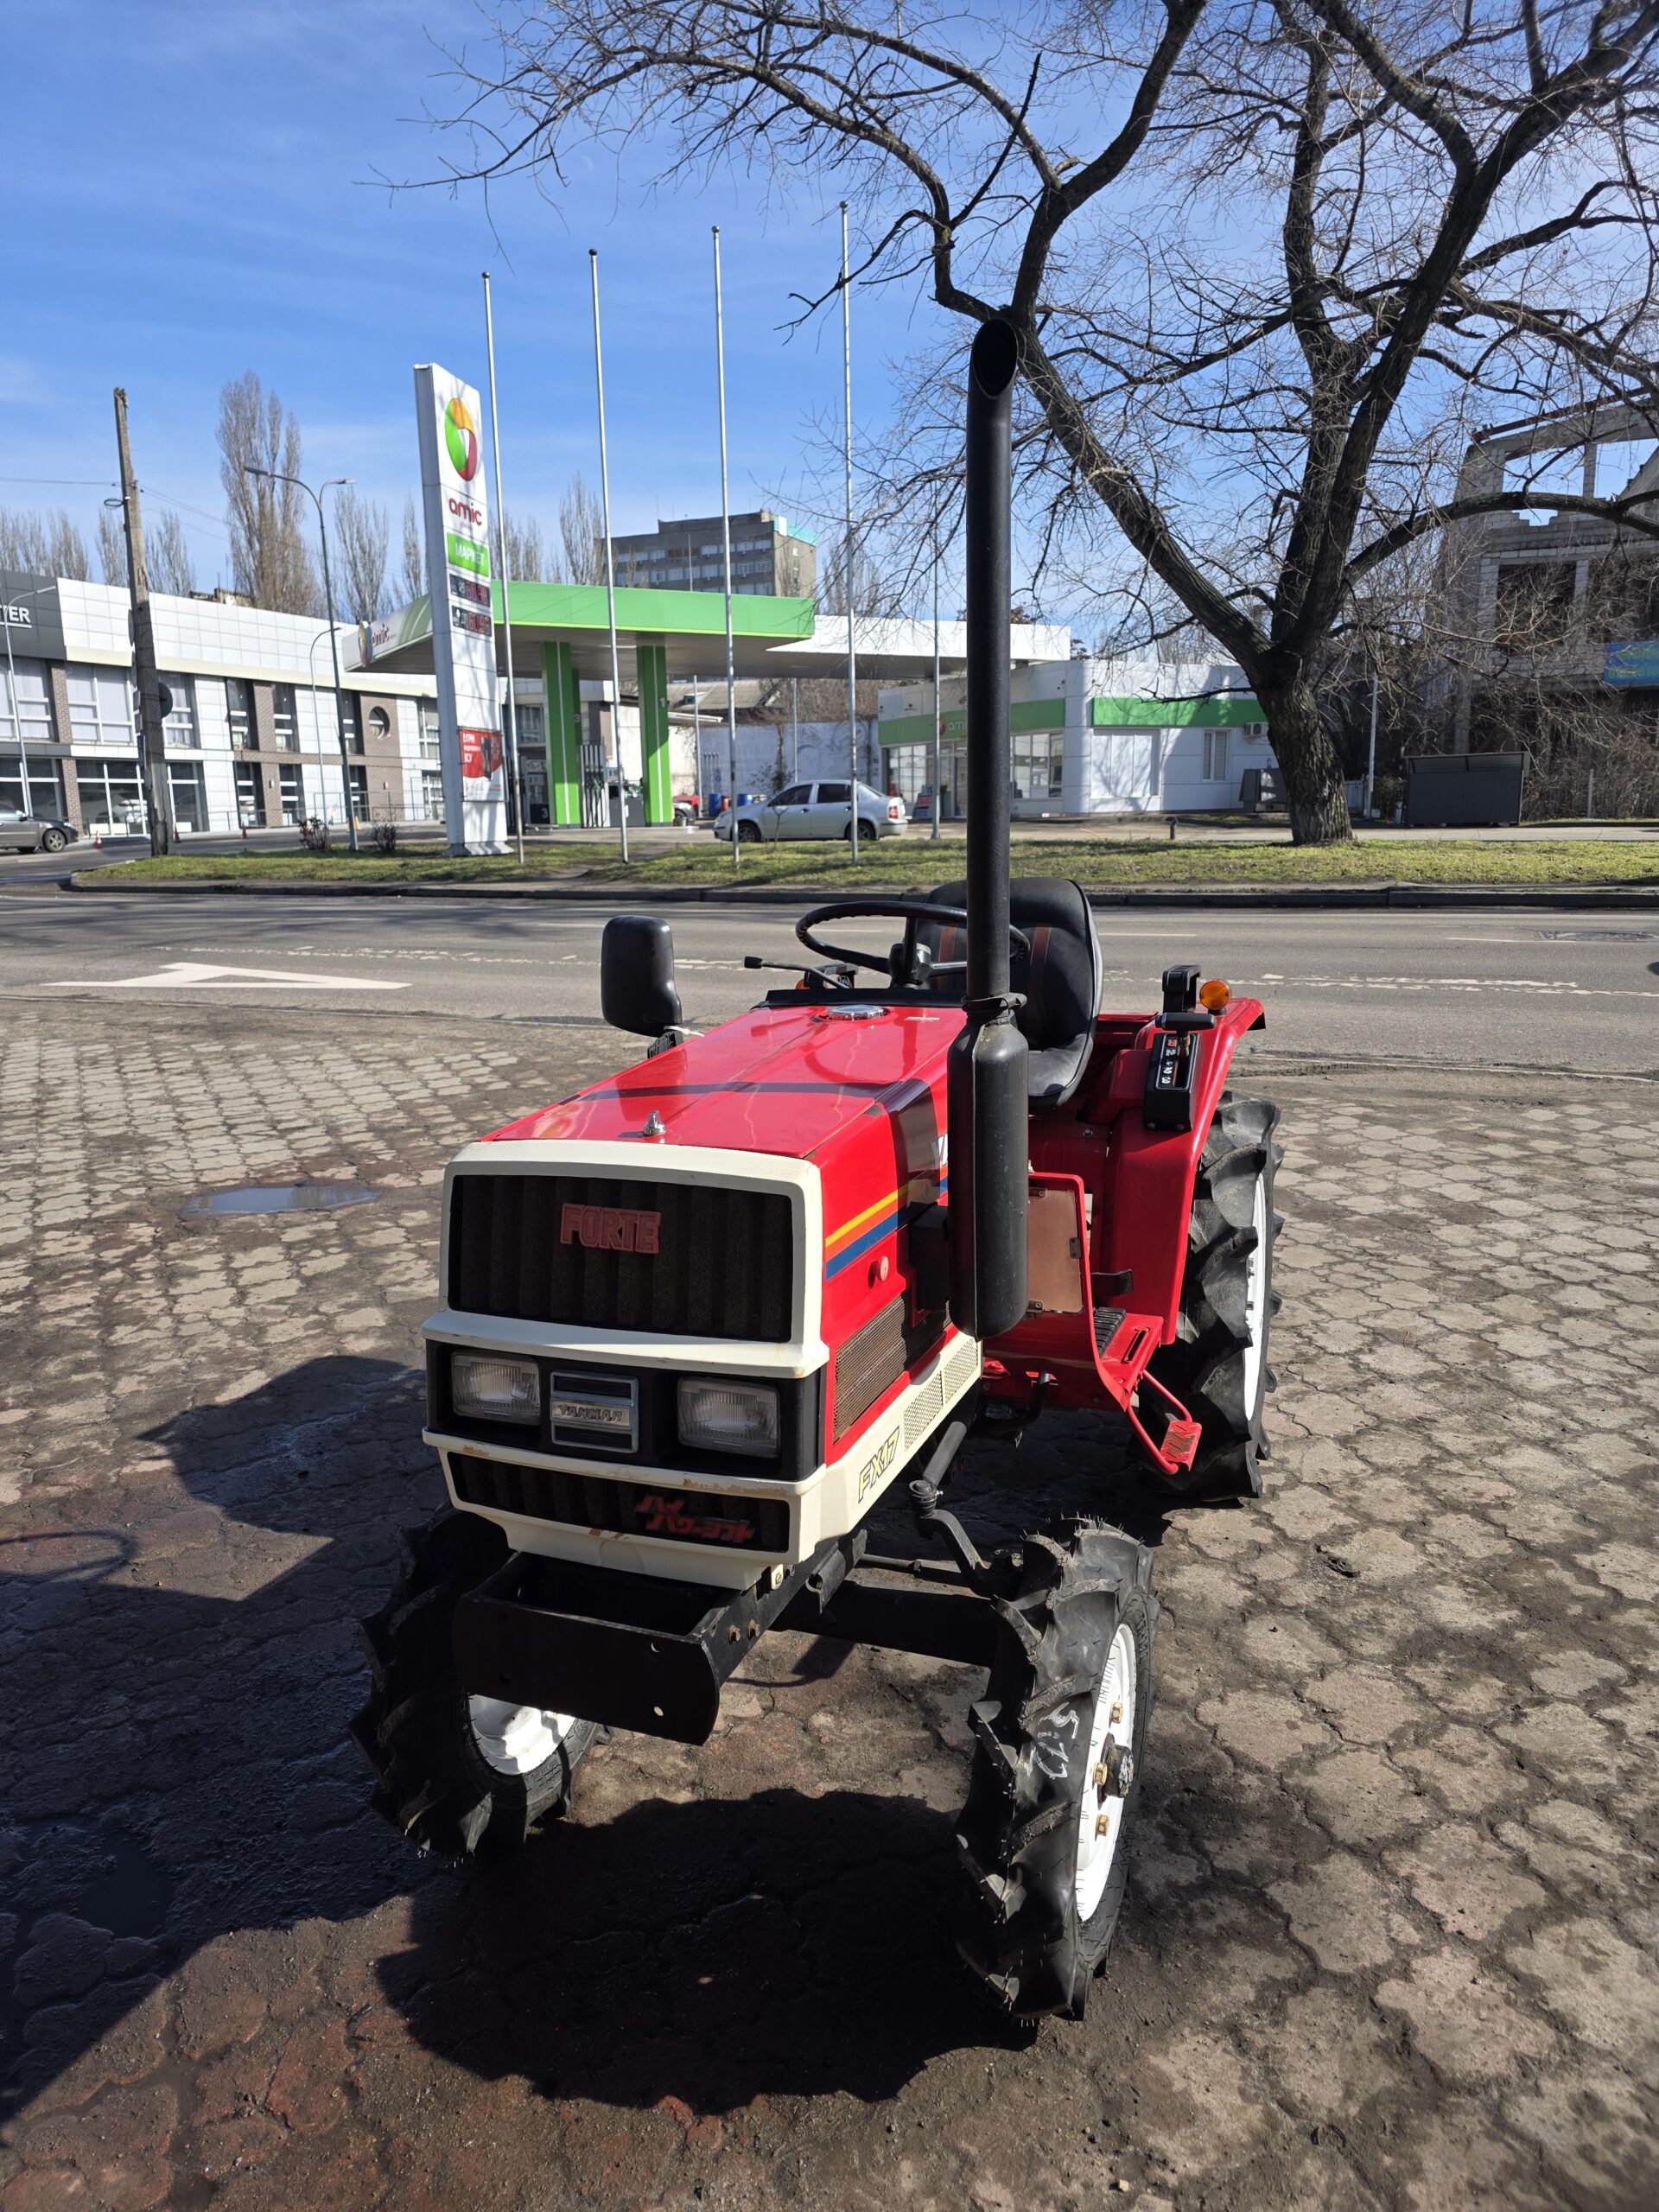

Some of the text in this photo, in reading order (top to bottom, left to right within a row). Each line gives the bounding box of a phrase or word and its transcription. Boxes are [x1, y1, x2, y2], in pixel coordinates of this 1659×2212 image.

[448, 498, 482, 525] amic
[454, 543, 485, 566] МАРКЕТ
[574, 714, 581, 723] 3
[542, 807, 549, 818] 3
[560, 1202, 661, 1255] FORTE
[558, 1404, 623, 1422] YANMAR
[858, 1426, 900, 1503] FX17
